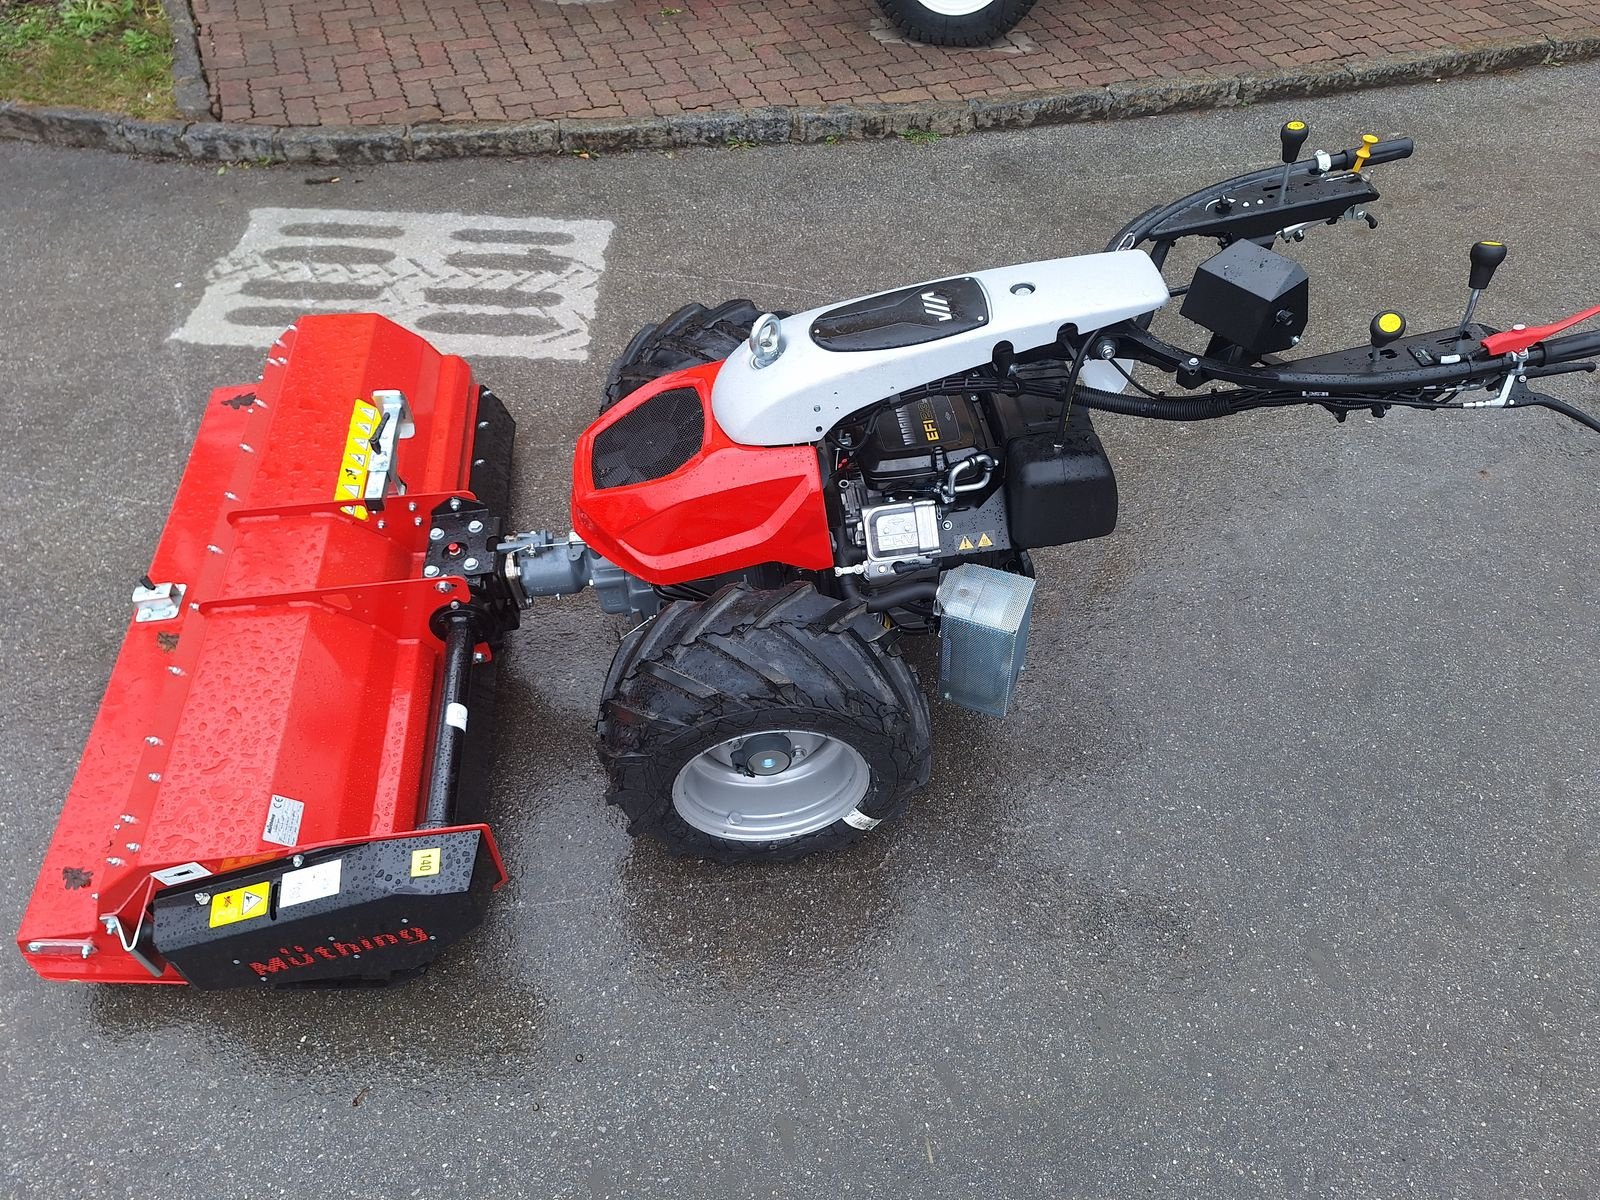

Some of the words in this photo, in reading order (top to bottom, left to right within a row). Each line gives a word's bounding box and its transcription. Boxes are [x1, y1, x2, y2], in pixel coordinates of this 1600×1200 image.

[922, 419, 940, 441] EFI
[419, 853, 432, 872] 140
[248, 927, 430, 976] Müthing
